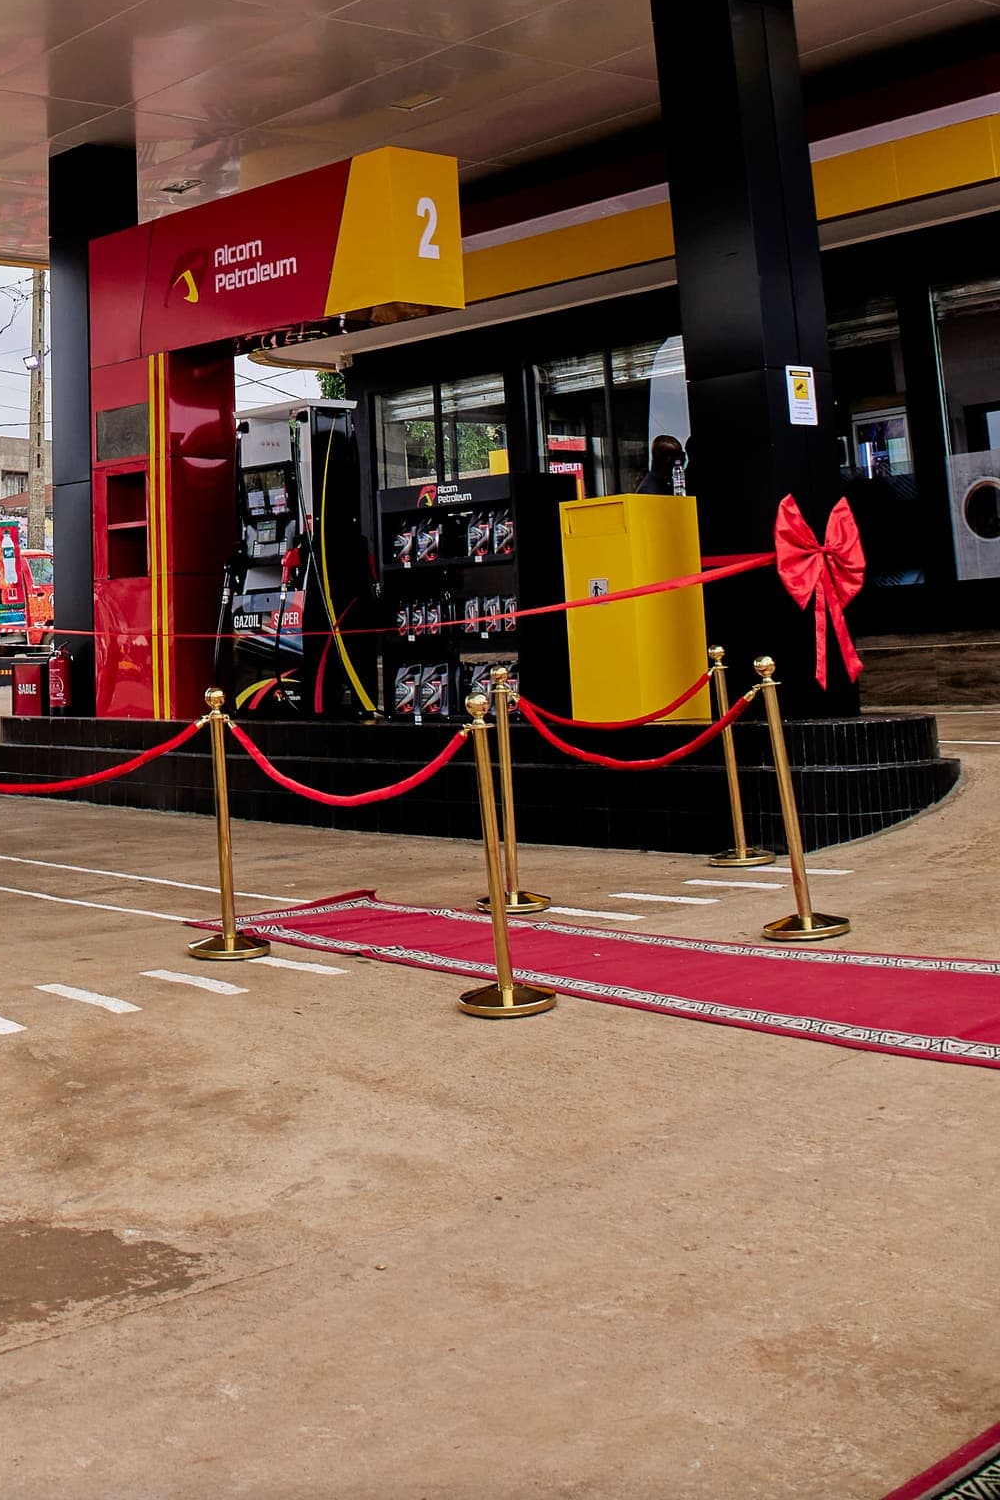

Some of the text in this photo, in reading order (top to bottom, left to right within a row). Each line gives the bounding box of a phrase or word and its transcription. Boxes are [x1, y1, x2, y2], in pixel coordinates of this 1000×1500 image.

[416, 196, 440, 260] 2
[214, 239, 262, 268] Alcom
[215, 256, 297, 293] Petroleum
[437, 485, 458, 495] Alcom
[437, 492, 472, 504] Petroleum
[233, 614, 261, 629] GAZOIL
[273, 611, 299, 626] SPER
[17, 683, 37, 695] SABLE
